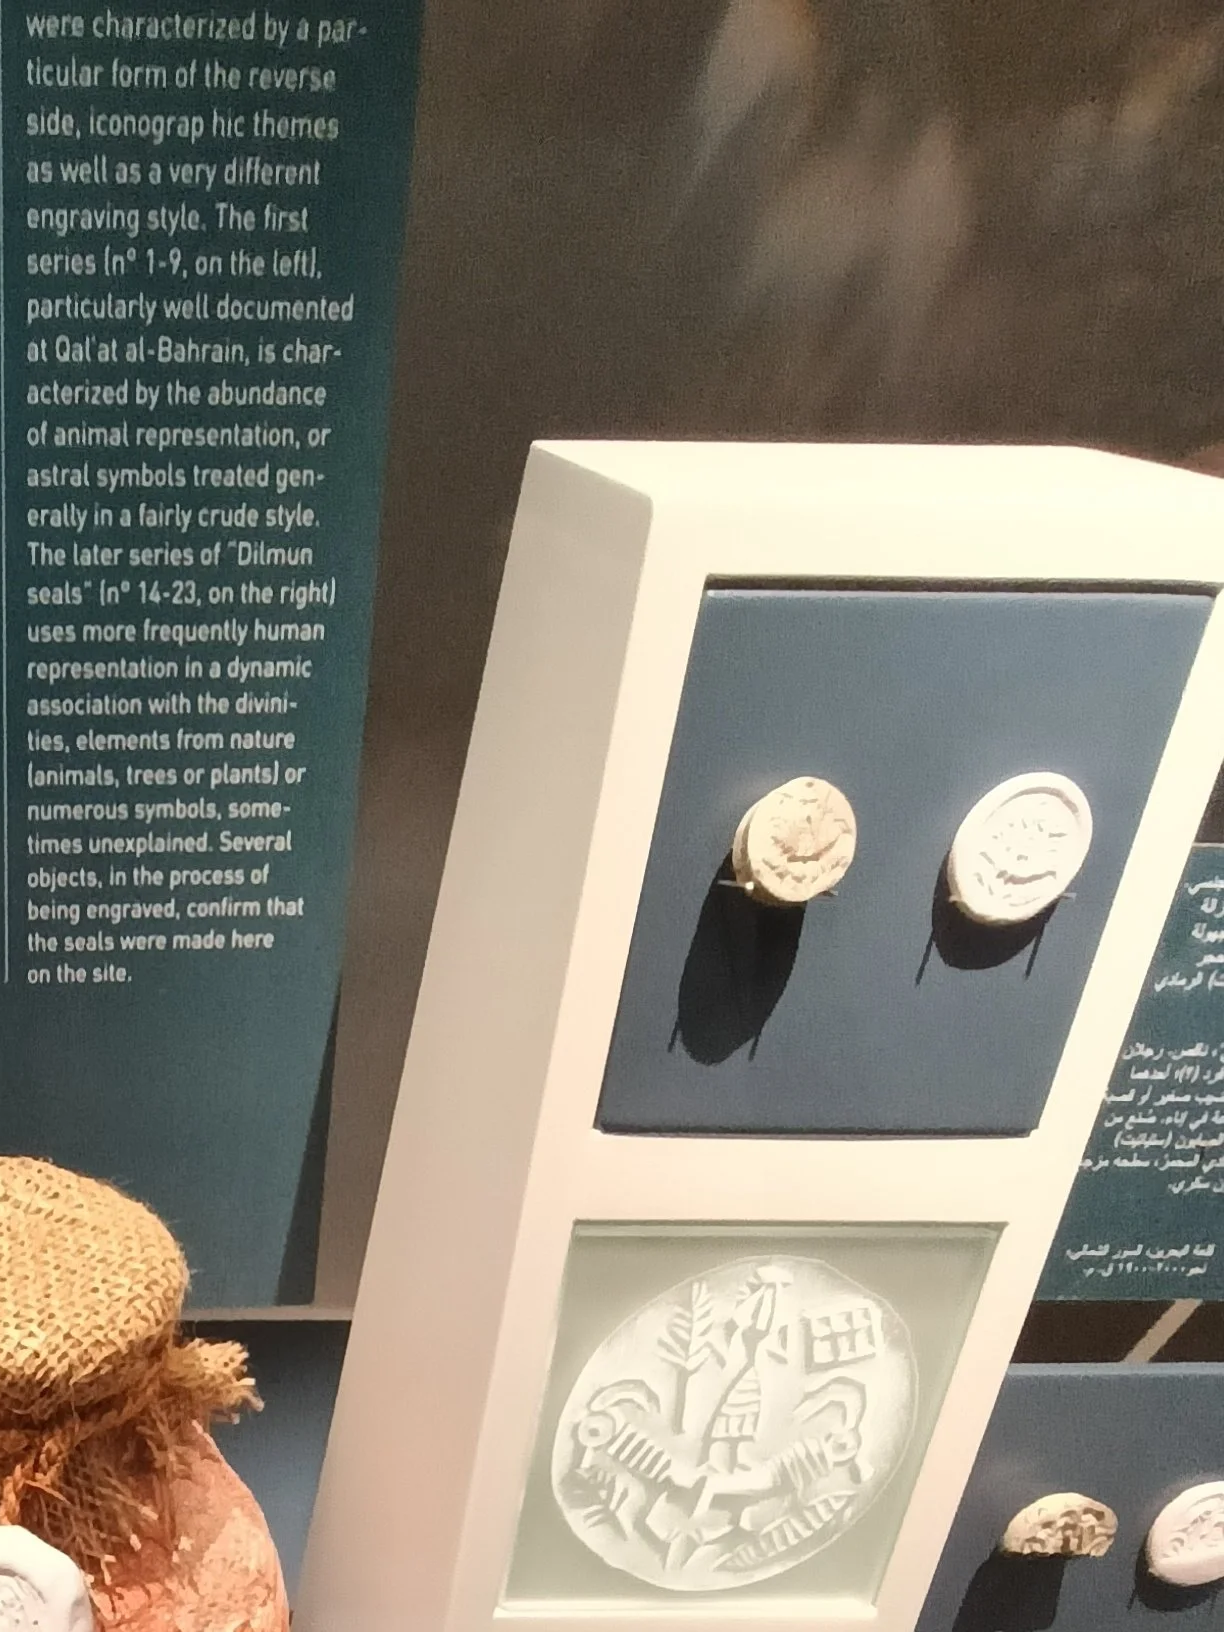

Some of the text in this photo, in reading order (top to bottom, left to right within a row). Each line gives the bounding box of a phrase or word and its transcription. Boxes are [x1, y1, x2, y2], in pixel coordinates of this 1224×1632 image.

[26, 9, 366, 48] were characterized by a par-
[27, 55, 335, 91] ticular form of the reverse
[27, 106, 338, 145] side, iconograp hic themes
[27, 202, 307, 238] engraving style. The first
[28, 247, 96, 275] series
[147, 247, 187, 278] 1-9,
[196, 256, 222, 275] on
[231, 249, 264, 276] the
[273, 247, 321, 279] left),
[28, 292, 353, 325] particularly well documented
[27, 339, 47, 362] at
[126, 336, 249, 366] al-Bahrain,
[259, 338, 275, 363] is
[283, 337, 341, 364] char-
[27, 421, 331, 452] of animal representation, or
[28, 501, 319, 533] erally in a fairly crude style.
[28, 542, 65, 566] The
[74, 542, 123, 565] later
[130, 542, 193, 566] series
[201, 542, 221, 565] of
[139, 580, 201, 606] 14-23,
[209, 587, 233, 604] on
[241, 581, 273, 604] the
[280, 577, 335, 610] right)
[27, 690, 297, 716] association with the divini-
[28, 760, 306, 789] (animals, trees or plants) or
[28, 797, 290, 823] numerous symbols, some-
[28, 863, 269, 892] objects, in the process of
[28, 896, 304, 925] being engraved, confirm that
[28, 928, 274, 952] the seals were made here
[28, 963, 131, 984] on the site.
